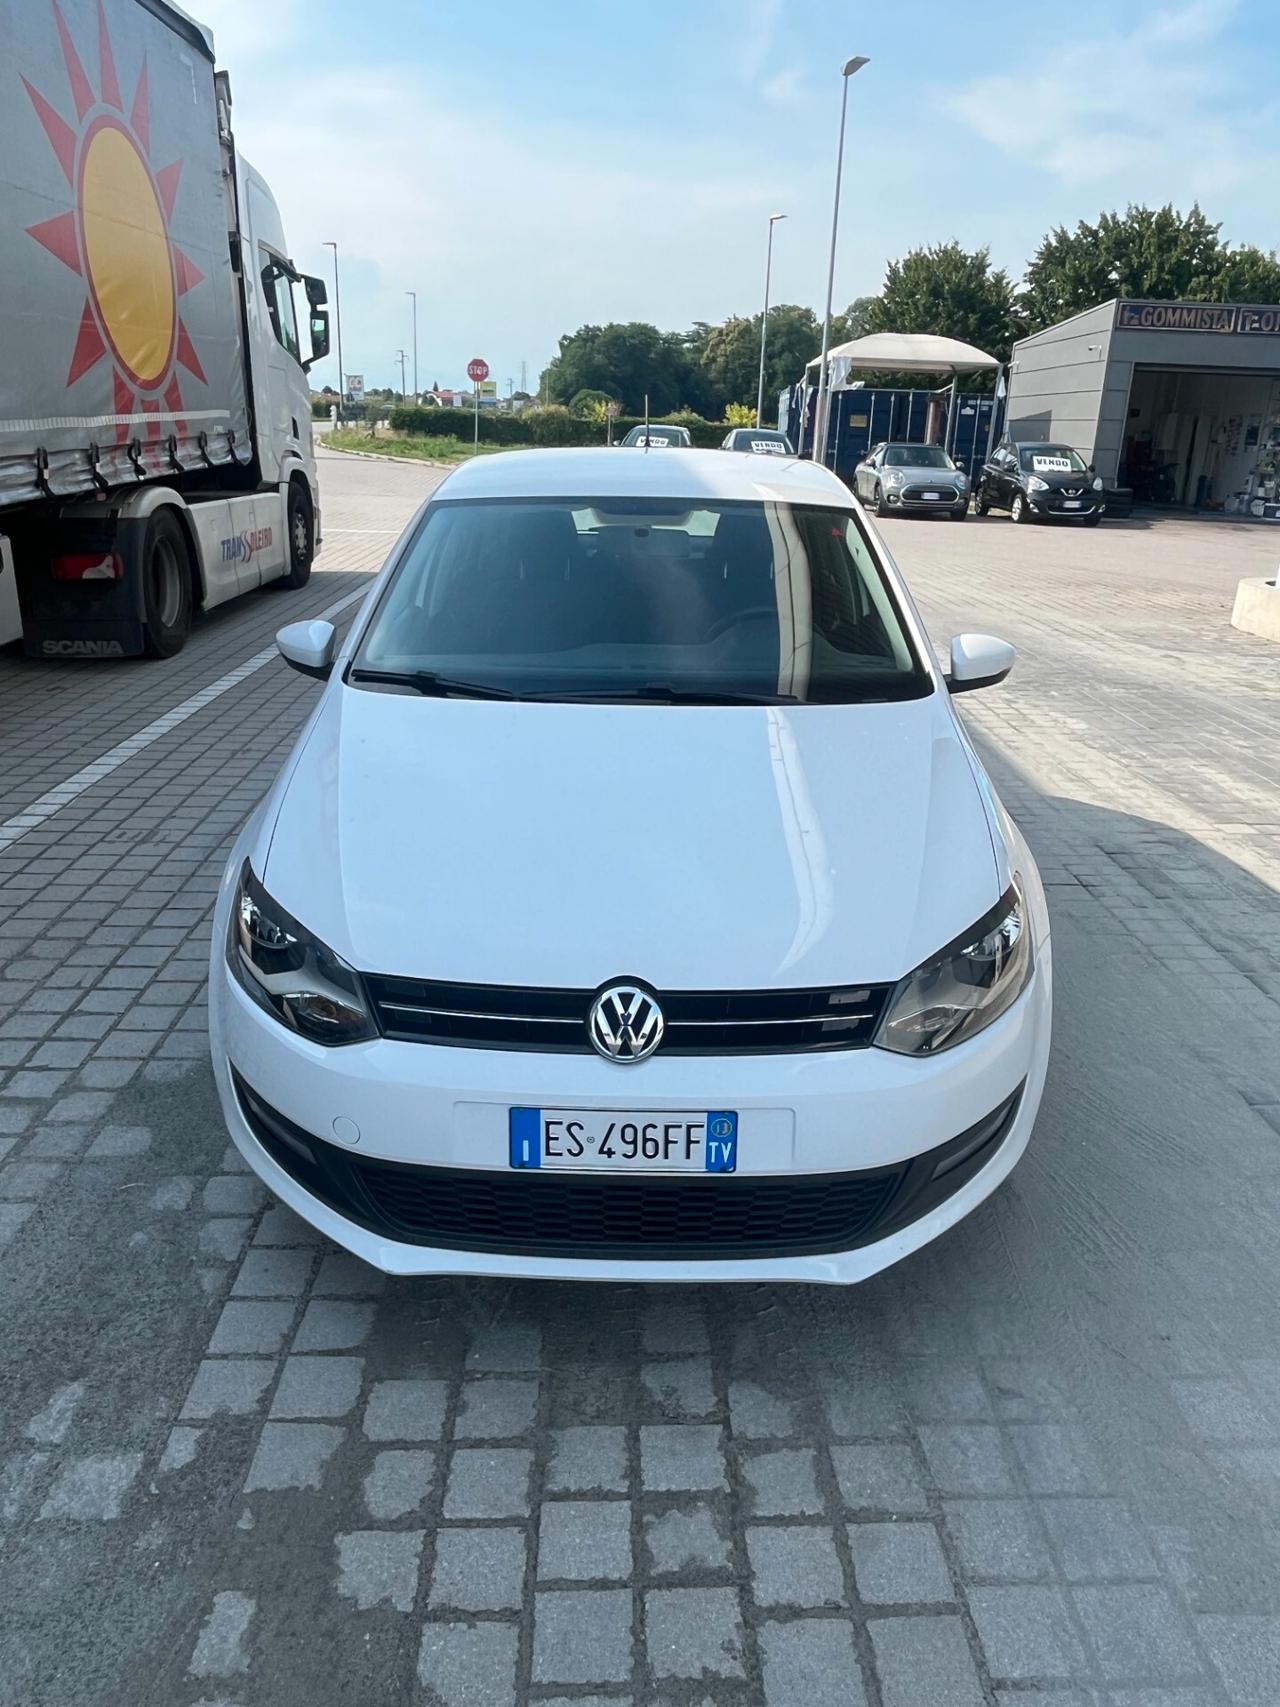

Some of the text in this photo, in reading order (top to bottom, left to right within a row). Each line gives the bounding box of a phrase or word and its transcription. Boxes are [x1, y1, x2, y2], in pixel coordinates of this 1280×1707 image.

[1141, 307, 1229, 329] GOMMISTA
[469, 365, 488, 375] STOP
[1036, 458, 1069, 467] VENDO
[42, 640, 123, 655] SCANIA
[708, 1141, 732, 1163] TV
